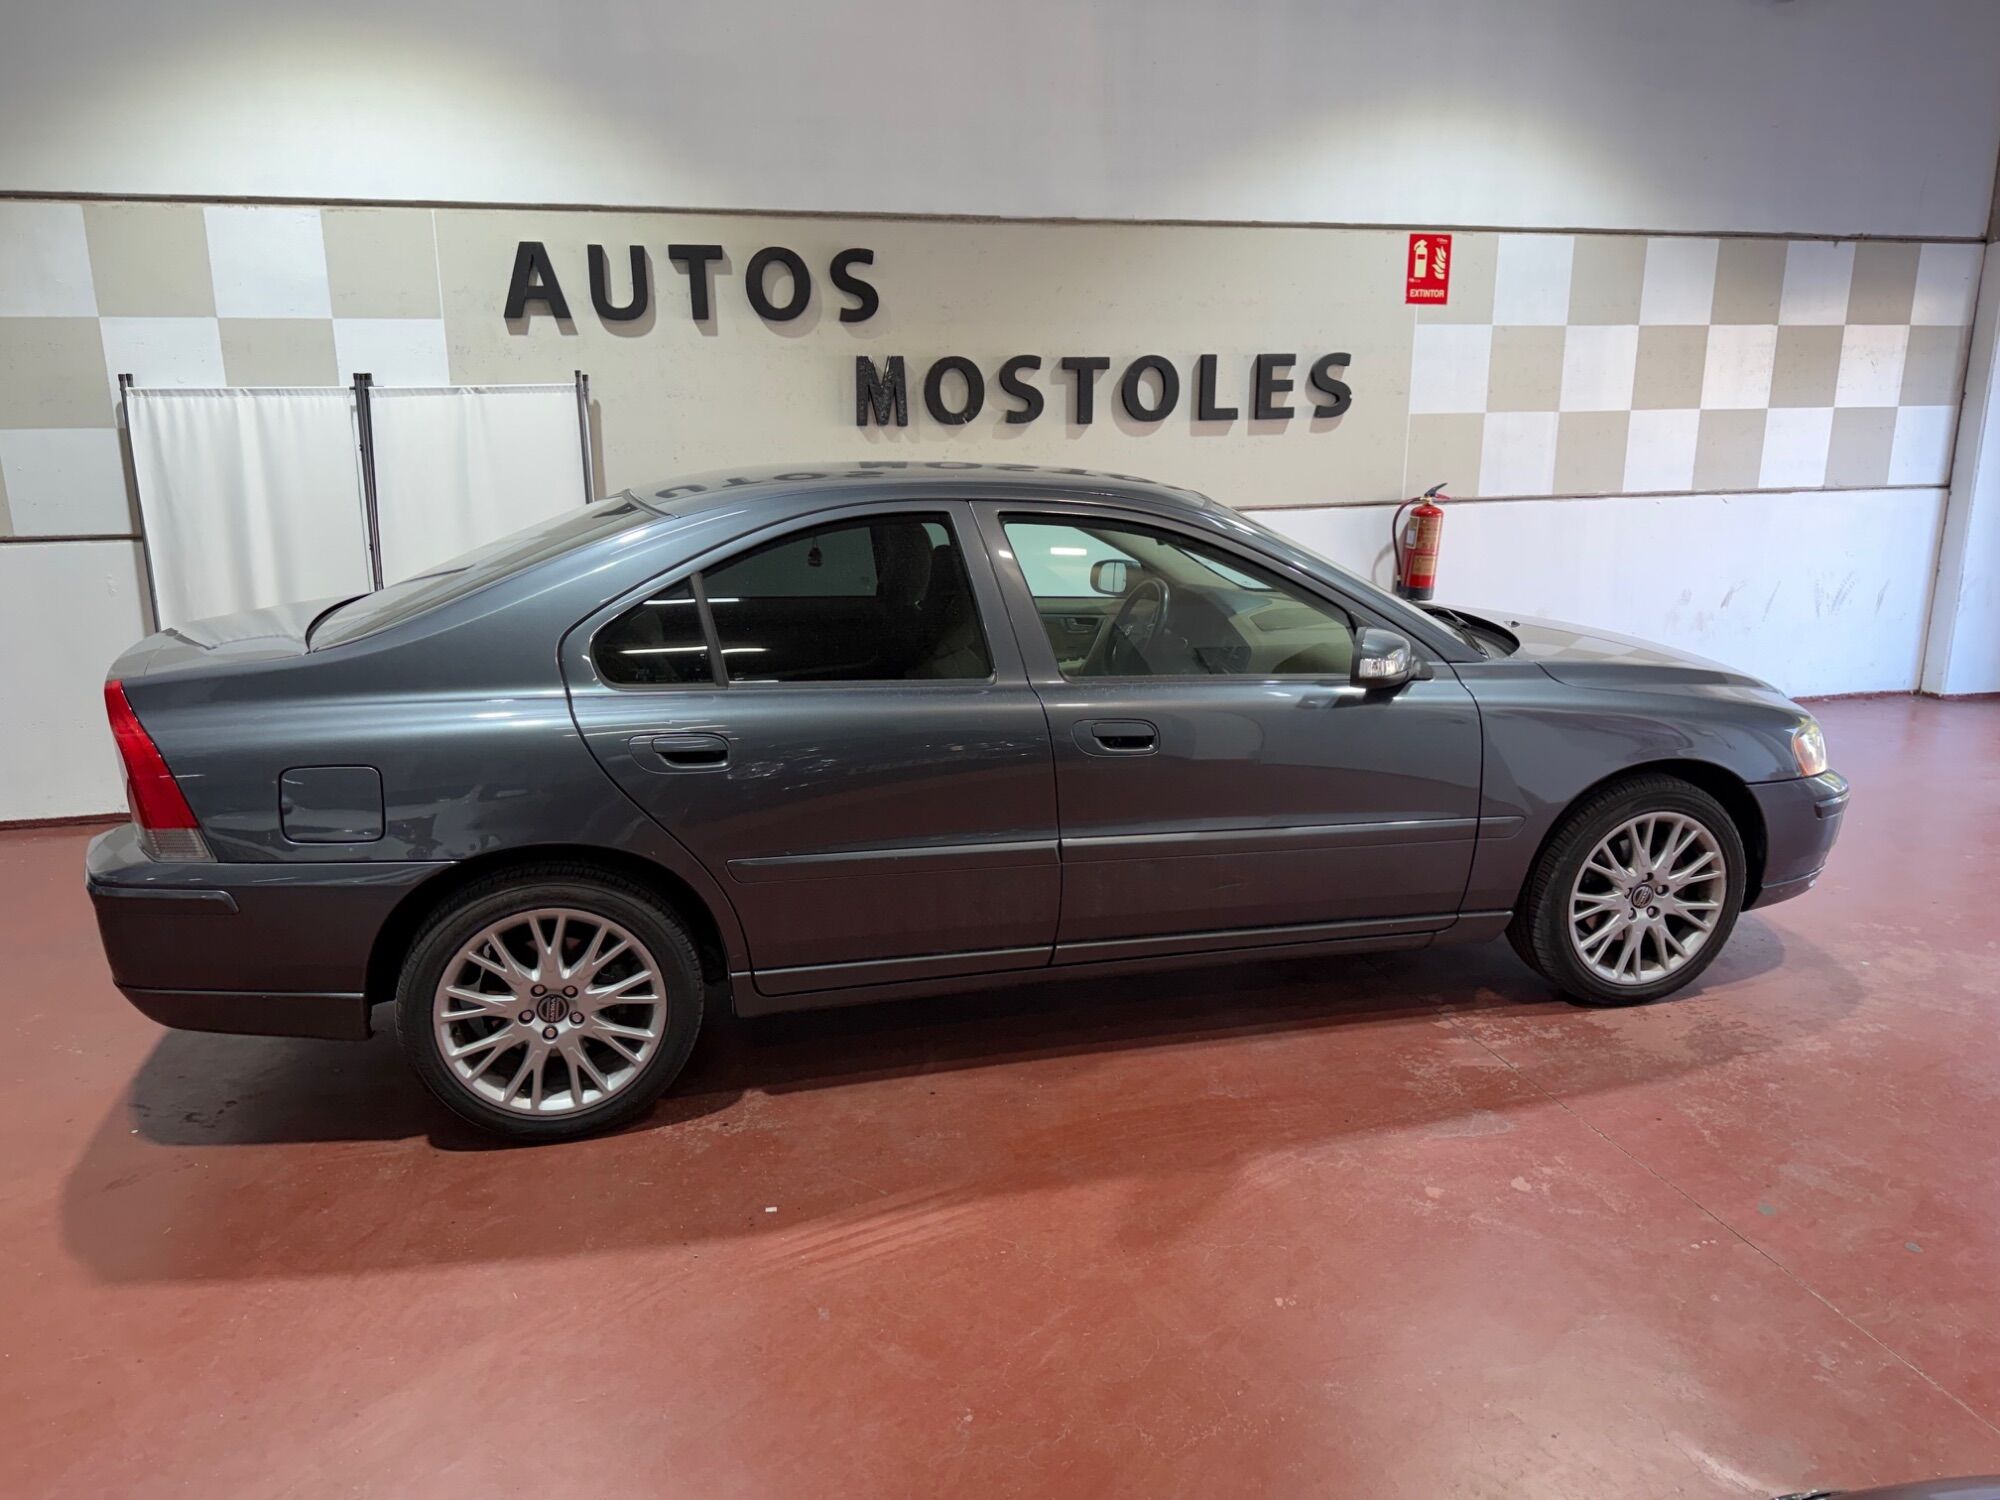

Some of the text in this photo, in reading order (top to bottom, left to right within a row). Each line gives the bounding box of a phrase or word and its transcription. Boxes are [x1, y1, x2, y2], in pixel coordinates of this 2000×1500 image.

[503, 241, 880, 324] AUTOS
[1409, 288, 1445, 298] EXTINTOR
[855, 352, 1352, 428] MOSTOLES
